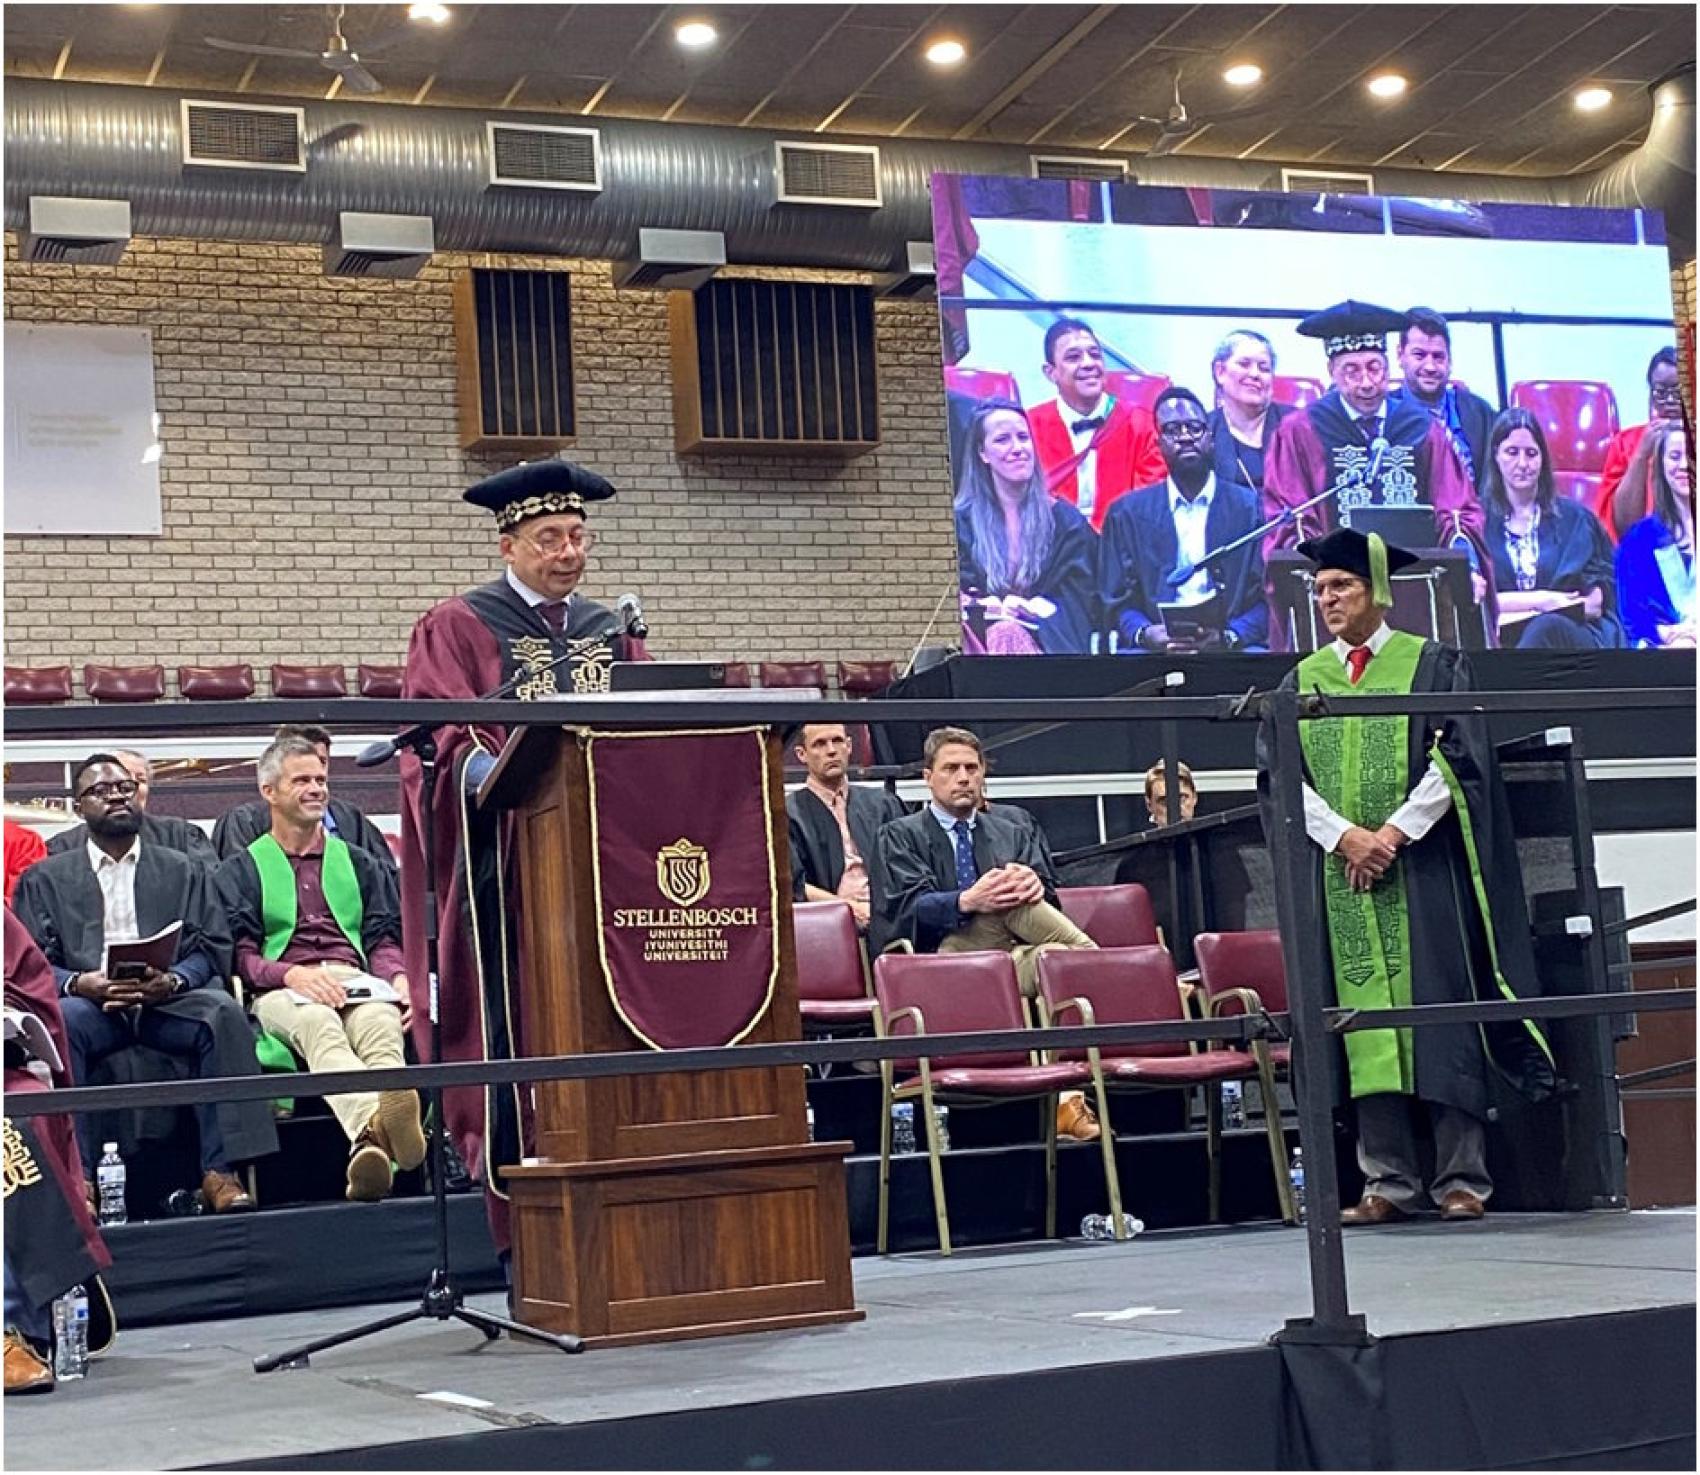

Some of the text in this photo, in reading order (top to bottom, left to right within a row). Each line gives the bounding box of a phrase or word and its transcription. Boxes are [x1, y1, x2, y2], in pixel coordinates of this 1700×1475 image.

[613, 907, 758, 926] STELLENBOSCH
[649, 928, 722, 939] UNIVERSITY
[645, 940, 728, 950] IYUNIVESITHI
[644, 950, 728, 960] UNIVERSITEIT
